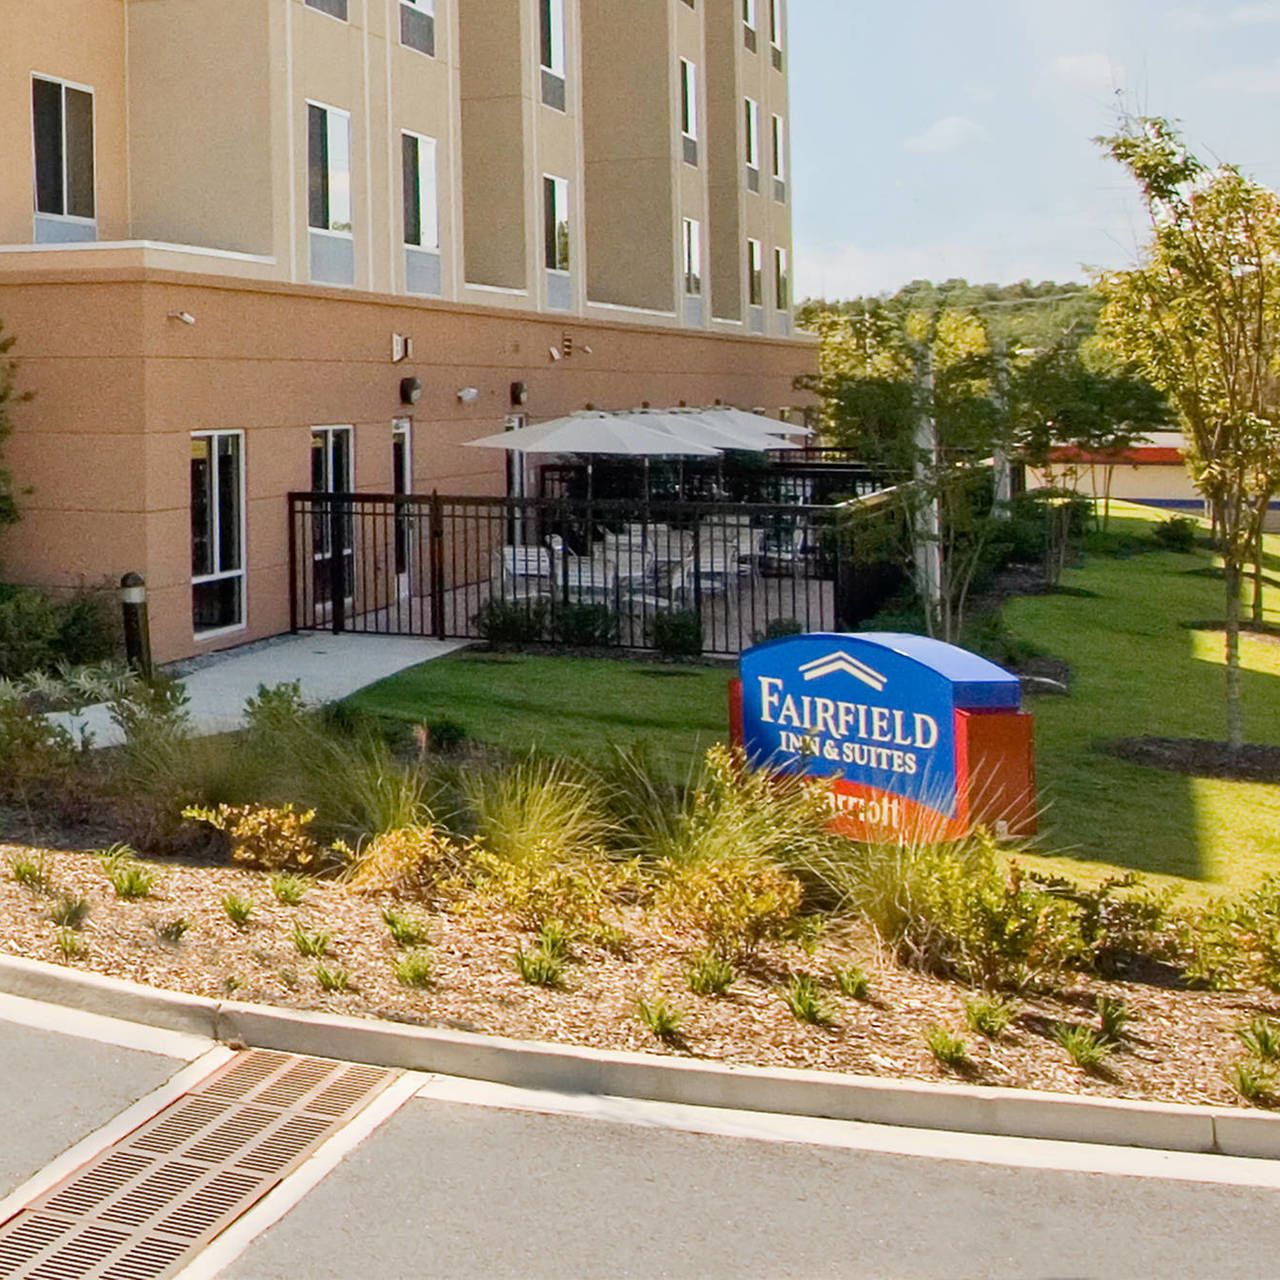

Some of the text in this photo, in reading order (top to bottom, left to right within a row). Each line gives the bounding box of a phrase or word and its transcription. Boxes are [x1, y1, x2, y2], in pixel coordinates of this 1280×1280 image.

[757, 675, 939, 750] FAIRFIELD
[823, 738, 841, 761] &
[842, 741, 917, 775] SUITES
[802, 788, 900, 829] arriott
